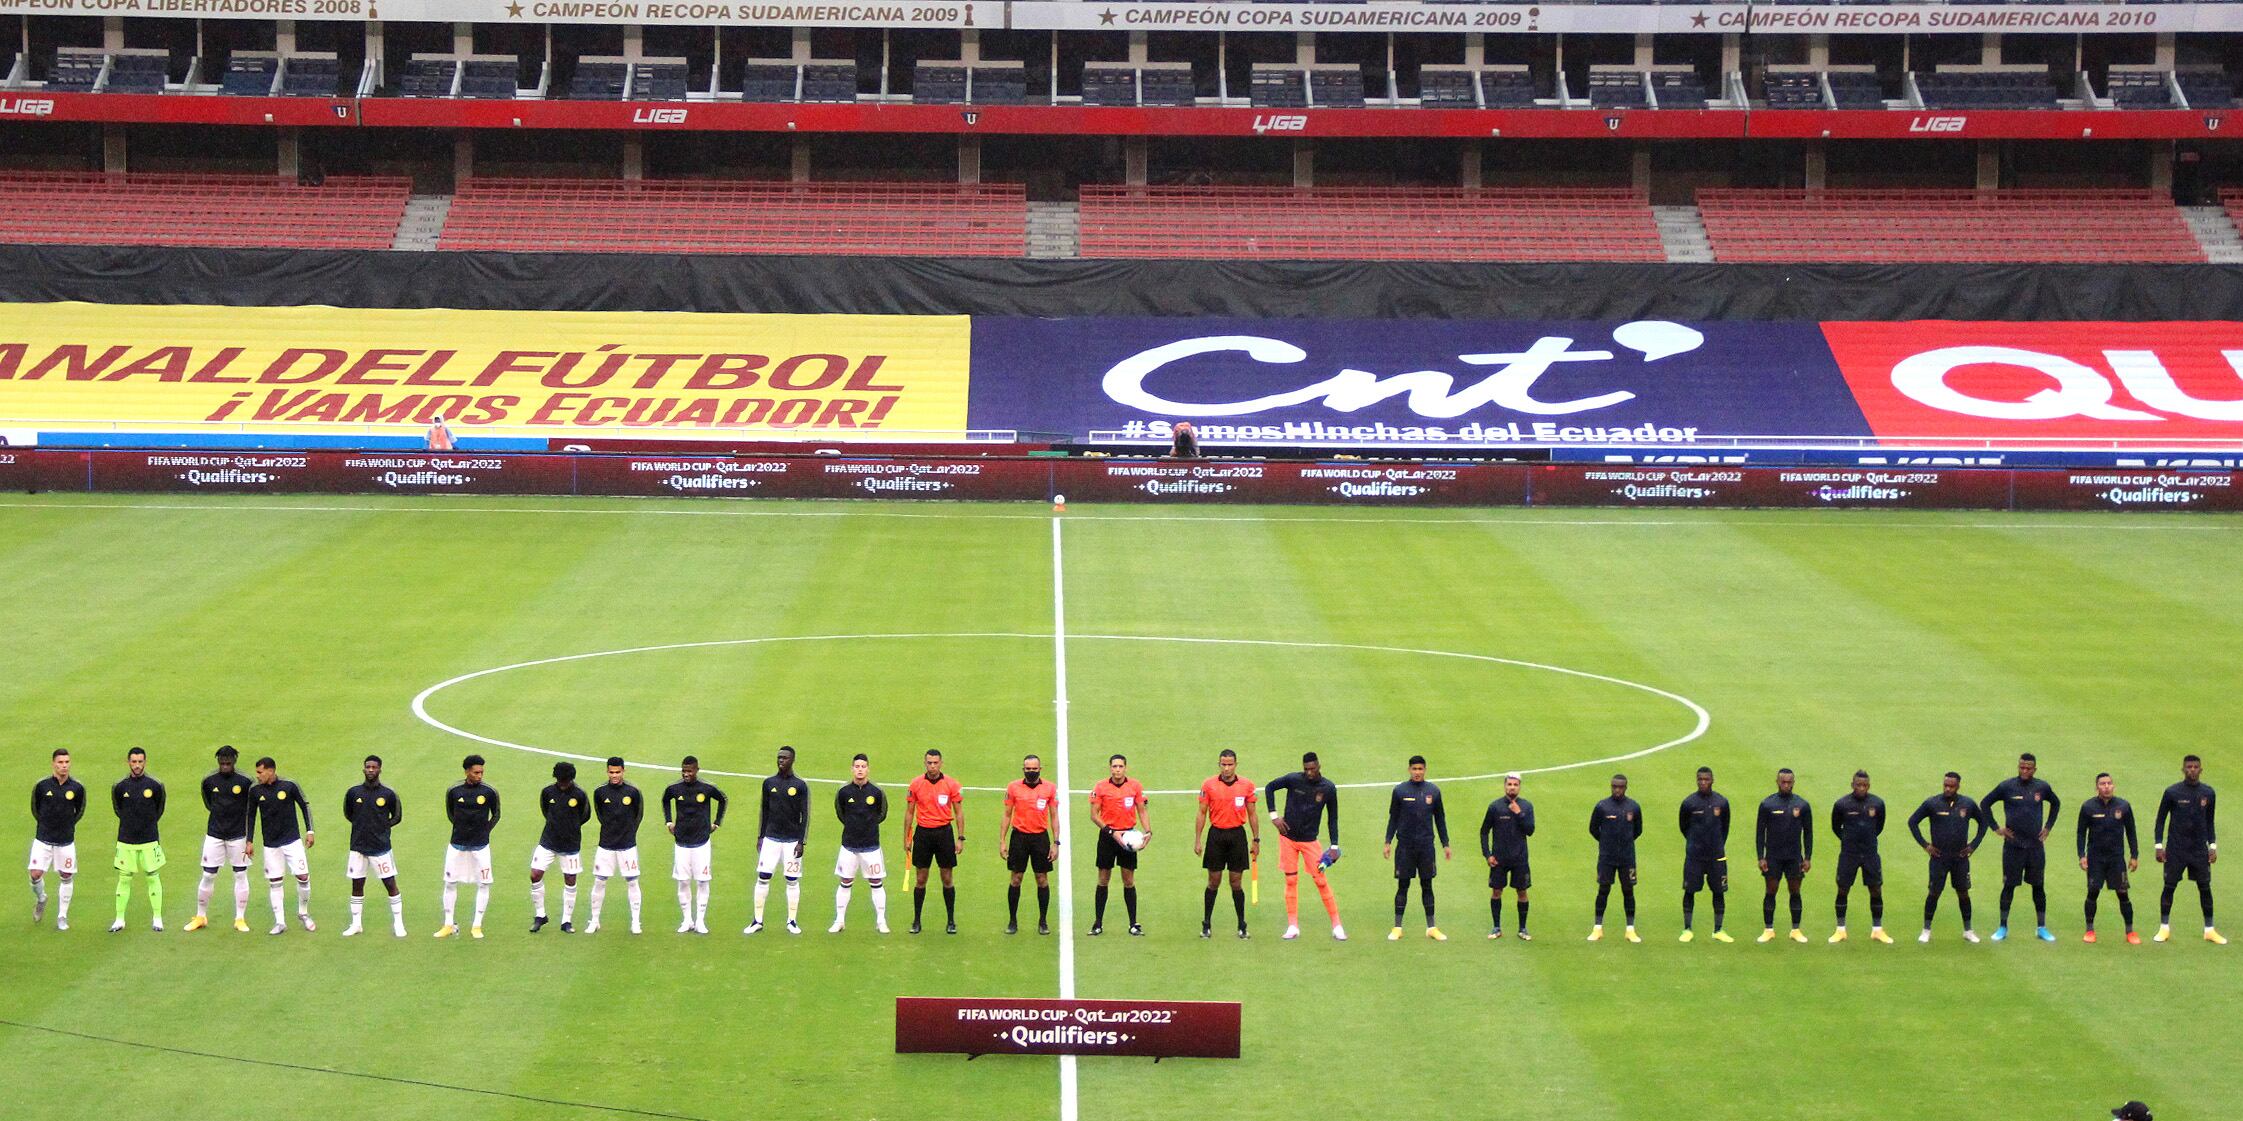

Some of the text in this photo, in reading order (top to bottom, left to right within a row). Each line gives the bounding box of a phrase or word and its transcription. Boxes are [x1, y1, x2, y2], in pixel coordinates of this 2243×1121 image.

[81, 0, 140, 10] COPA
[147, 0, 307, 13] LIBERTADORES
[314, 1, 361, 14] 2008
[533, 0, 958, 21] CAMPEÓN RECOPA SUDAMERICANA 2009
[1125, 7, 1522, 26] CAMPEÓN COPA SUDAMERICANA 2009
[1718, 9, 2157, 27] CAMPEÓN RECOPA SUDAMERICANA 2010
[205, 388, 520, 426] ¡VAMOS
[1122, 420, 1698, 443] #SmosHinchas del Ecuador
[148, 457, 170, 466] FIFA
[171, 457, 208, 466] WORLD
[210, 457, 230, 466] CUP
[346, 460, 368, 468] FIFA
[368, 460, 405, 468] WORLD
[406, 460, 426, 468] CUP
[631, 462, 653, 471] FIFA
[653, 462, 690, 471] WORLD
[692, 462, 711, 471] CUP
[824, 464, 848, 473] FIFA
[848, 464, 882, 473] WORLD
[886, 464, 903, 473] CUP
[1108, 468, 1130, 476] FIFA
[1130, 468, 1167, 476] WORLD
[1168, 468, 1188, 476] CUP
[1301, 469, 1323, 478] FIFA
[1324, 469, 1360, 478] WORLD
[1362, 469, 1381, 478] CUP
[188, 470, 266, 485] Qualifiers
[384, 472, 462, 487] Qualifiers
[670, 474, 748, 490] Qualifiers
[1585, 472, 1608, 481] FIFA
[1608, 472, 1645, 481] WORLD
[1646, 472, 1666, 481] CUP
[1780, 473, 1803, 482] FIFA
[1803, 473, 1840, 482] WORLD
[1842, 473, 1861, 482] CUP
[2070, 476, 2092, 484] FIFA
[2093, 476, 2131, 484] WORLD
[2132, 476, 2152, 484] CUP
[864, 477, 941, 493] Qualifiers
[1146, 480, 1224, 496] Qualifiers
[1340, 482, 1417, 497] Qualifiers
[1624, 484, 1702, 500] Qualifiers
[1820, 484, 1898, 500] Qualifiers
[2110, 488, 2190, 504] Qualifiers
[65, 858, 72, 868] 8
[378, 863, 390, 873] 16
[569, 858, 578, 869] 11
[625, 860, 636, 871] 14
[787, 862, 799, 873] 23
[869, 864, 880, 874] 10
[481, 868, 490, 879] 17
[702, 866, 709, 876] 4
[958, 1008, 988, 1021] FIFA
[990, 1008, 1040, 1021] WORLD
[1041, 1008, 1068, 1021] CUP
[1012, 1026, 1118, 1047] Qualifiers
